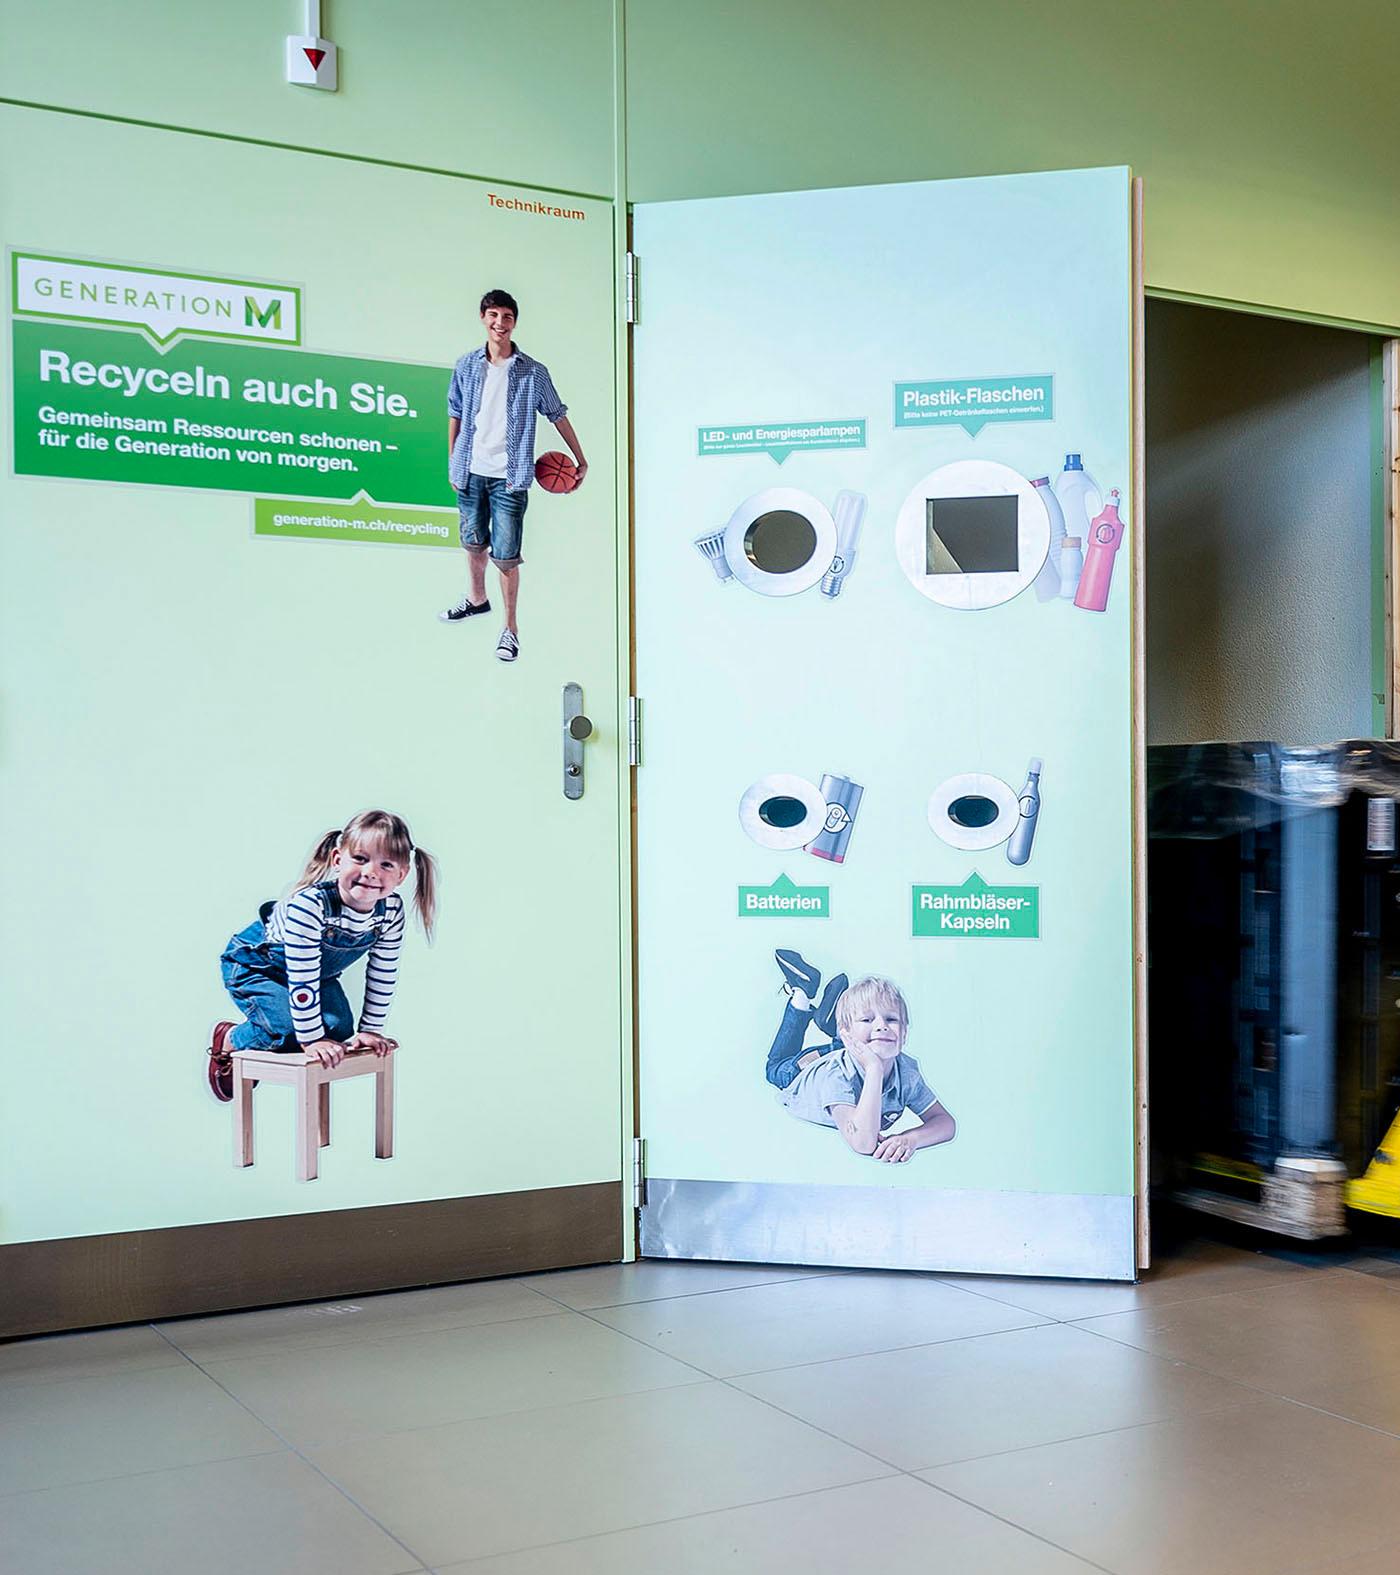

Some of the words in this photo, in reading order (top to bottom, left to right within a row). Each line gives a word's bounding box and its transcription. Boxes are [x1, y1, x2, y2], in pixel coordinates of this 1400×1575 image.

[487, 194, 585, 220] Technikraum
[34, 278, 232, 318] GENERATION
[244, 296, 282, 330] M
[39, 349, 230, 399] Recyceln
[243, 378, 337, 410] auch
[350, 383, 418, 418] Sie.
[903, 386, 1045, 407] Plastik-Flaschen
[38, 405, 167, 434] Gemeinsam
[173, 418, 294, 446] Ressourcen
[299, 431, 382, 453] schonen
[703, 431, 730, 443] LED-
[732, 430, 753, 441] und
[755, 425, 861, 441] Energiesparlampen
[38, 428, 70, 447] für
[75, 433, 109, 451] die
[115, 435, 230, 461] Generation
[236, 448, 273, 465] von
[278, 452, 359, 473] morgen.
[273, 513, 449, 538] generation-m.ch/recycling
[746, 894, 821, 909] Batterien
[920, 893, 1030, 910] Rahmbläser-
[940, 913, 1010, 932] Kapseln
